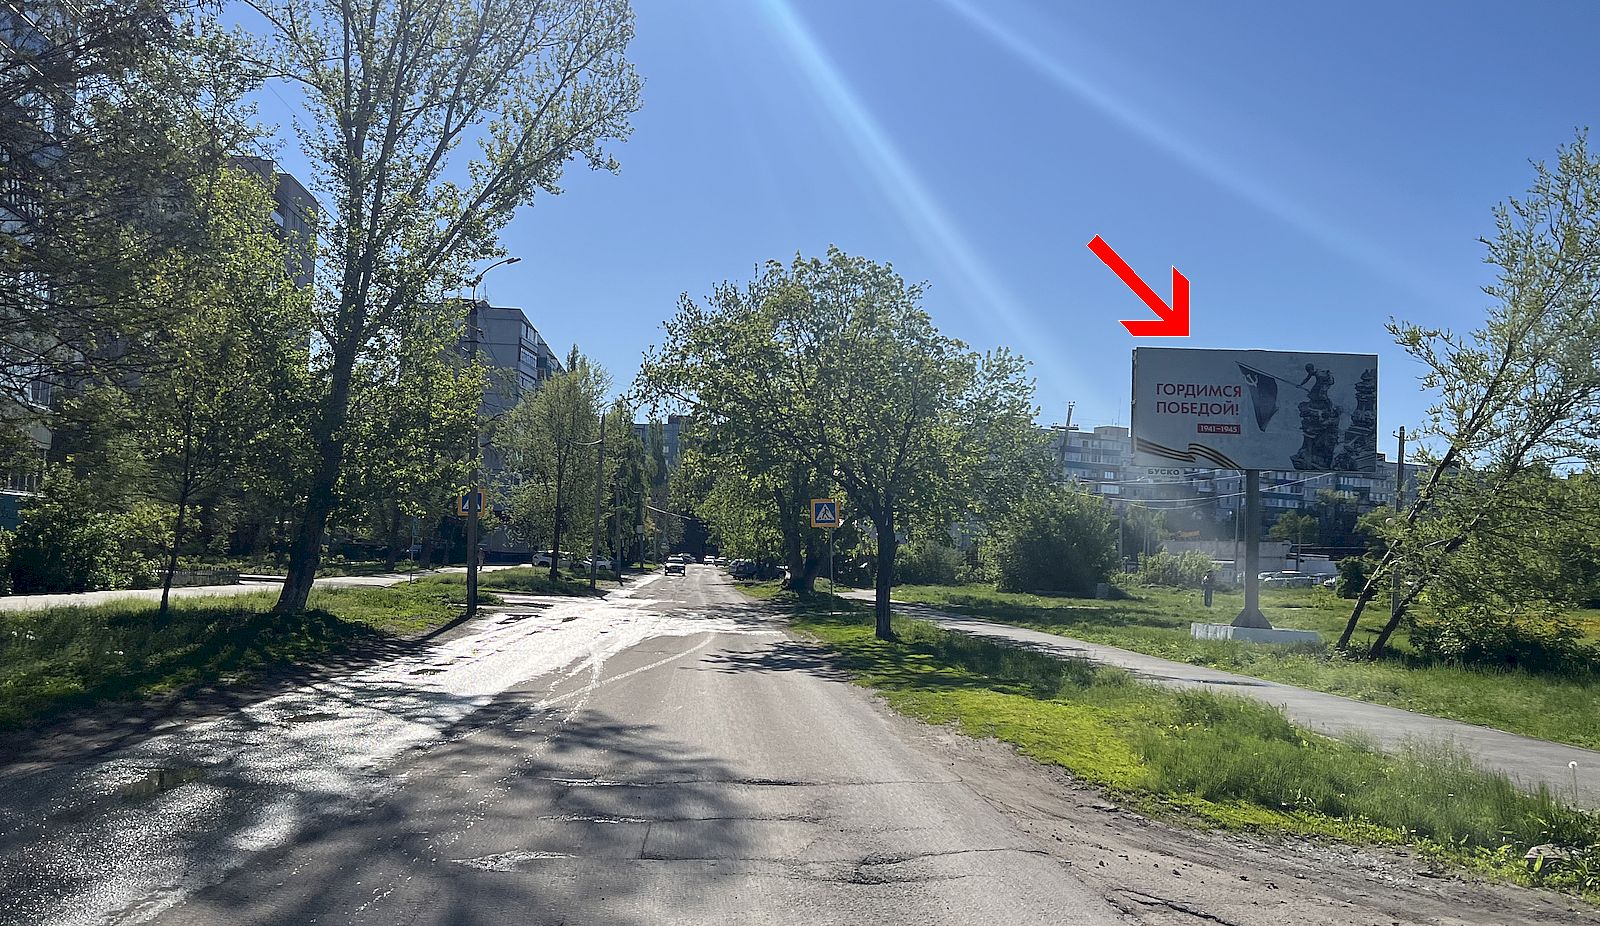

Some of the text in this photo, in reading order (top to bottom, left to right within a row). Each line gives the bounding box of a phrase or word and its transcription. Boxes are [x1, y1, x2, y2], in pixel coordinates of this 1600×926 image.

[1156, 383, 1241, 398] ГОРДИМСЯ
[1156, 400, 1239, 416] ПОБЕДОЙ!
[1147, 468, 1180, 476] БУСКО
